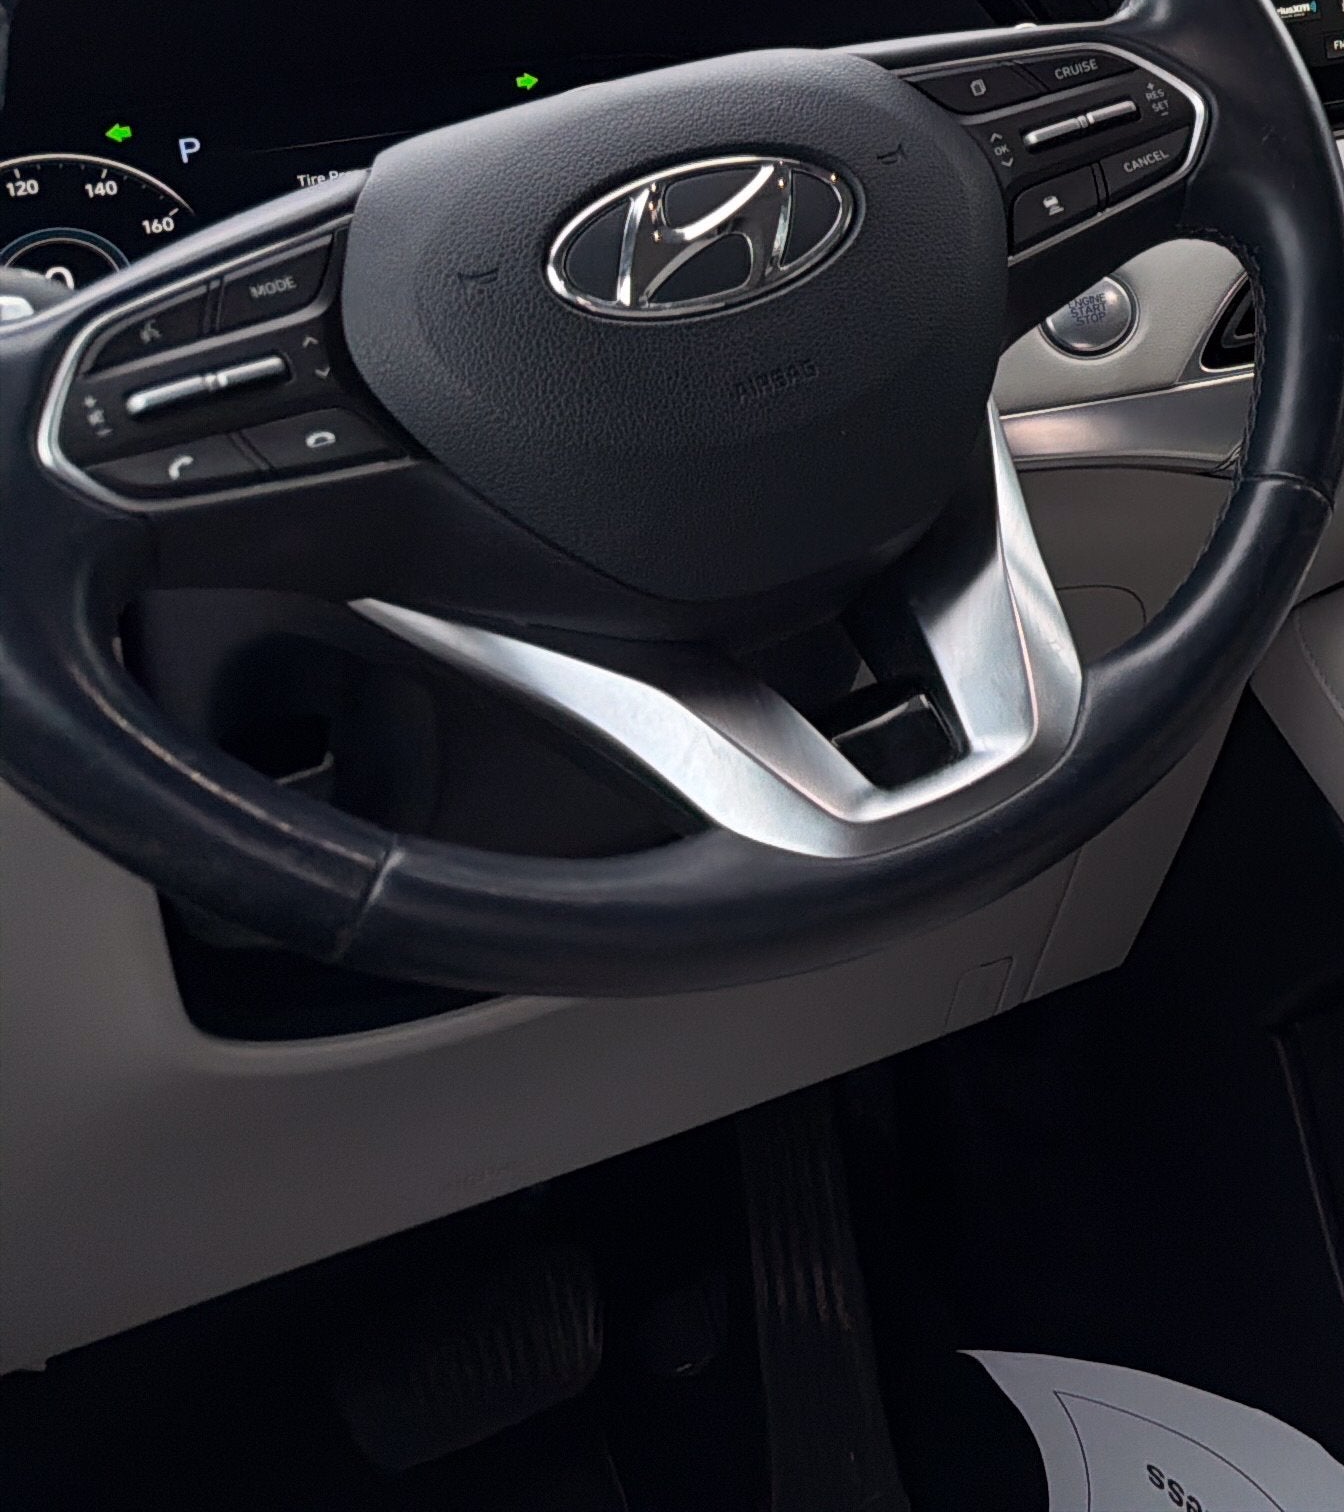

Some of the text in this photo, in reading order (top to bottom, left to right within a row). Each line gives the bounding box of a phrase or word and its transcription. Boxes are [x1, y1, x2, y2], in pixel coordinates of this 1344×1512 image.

[1054, 58, 1099, 80] CRUISE
[1145, 88, 1165, 100] RES
[1152, 99, 1169, 112] SET
[178, 137, 201, 164] P
[994, 144, 1010, 157] OK
[1123, 149, 1170, 173] CANCEL
[5, 179, 40, 198] 120
[296, 173, 326, 187] Tire
[84, 180, 118, 199] 140
[141, 216, 175, 235] 160
[249, 275, 298, 299] MODE
[1068, 292, 1106, 309] ENGINE
[1070, 303, 1107, 319] START
[1075, 312, 1106, 327] STOP
